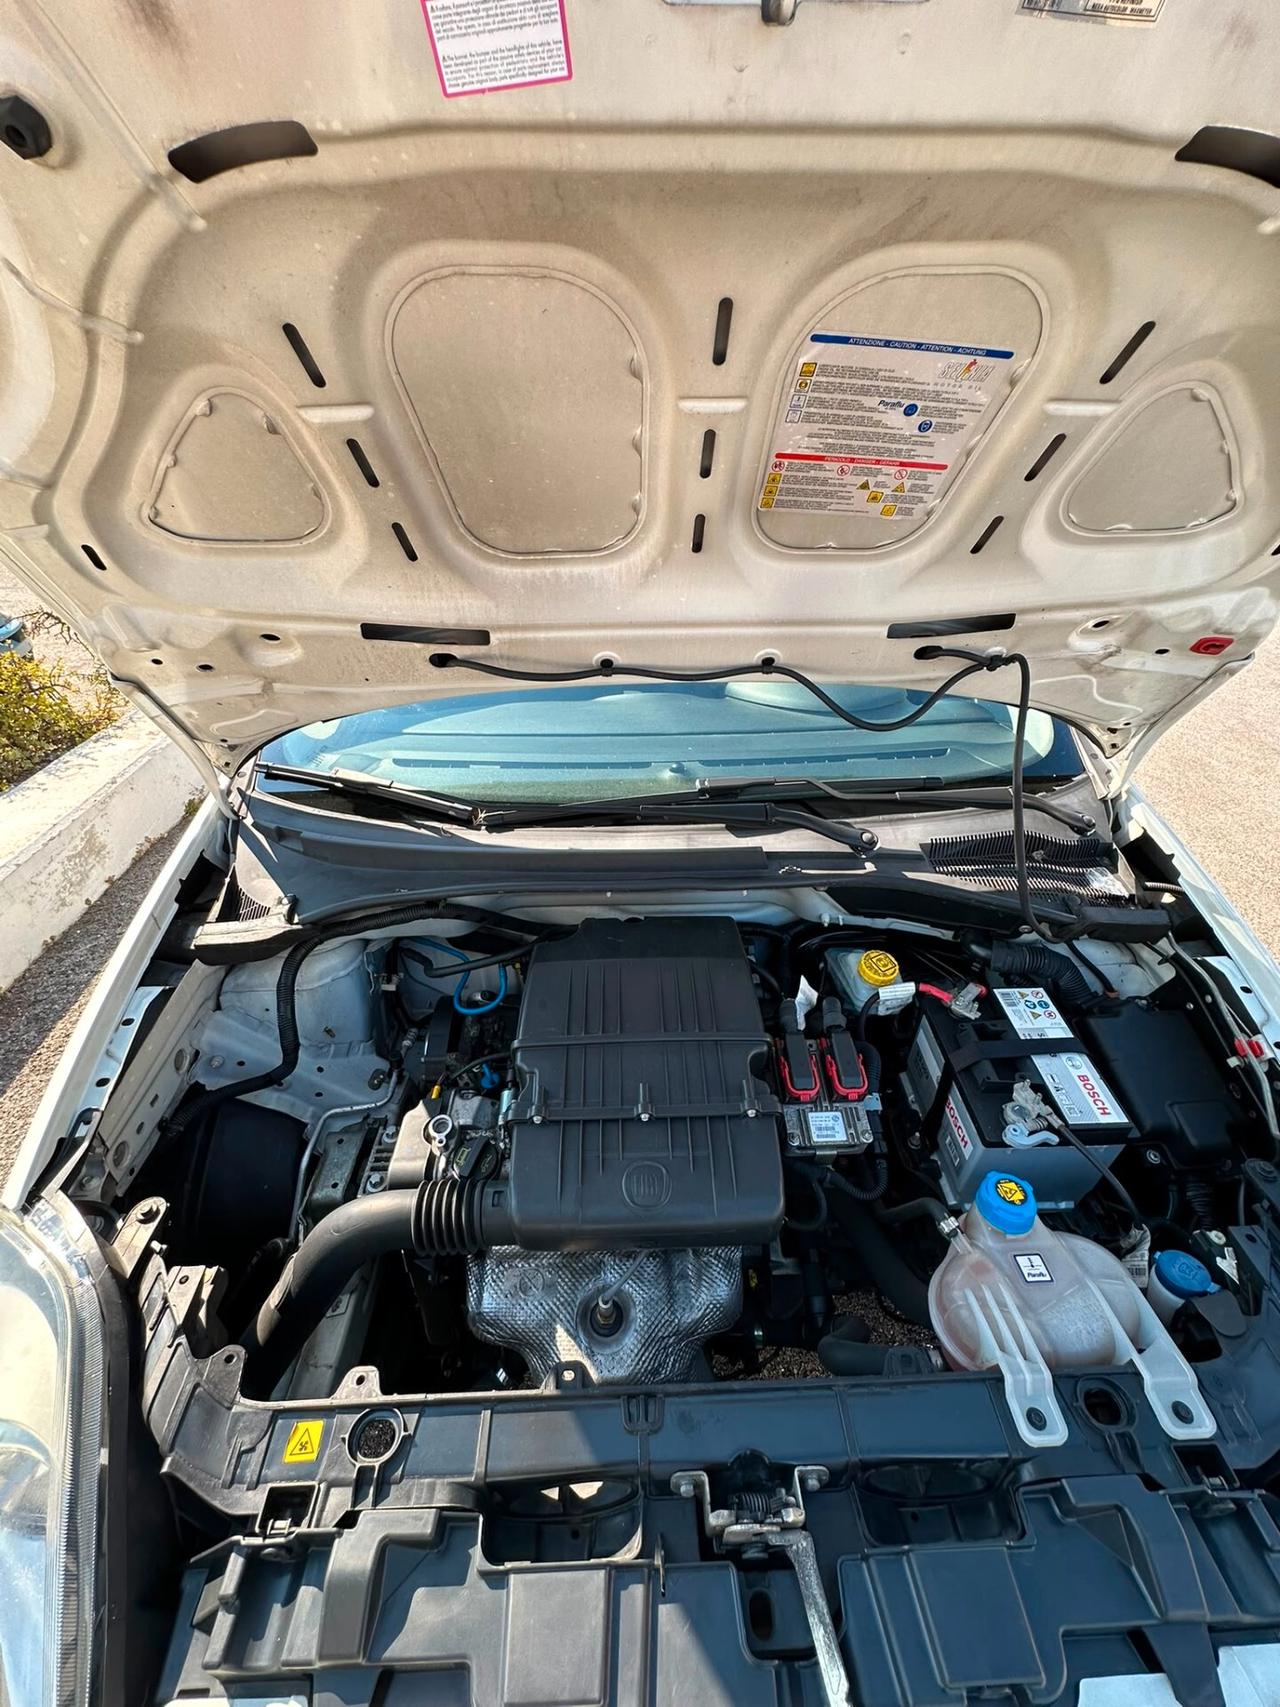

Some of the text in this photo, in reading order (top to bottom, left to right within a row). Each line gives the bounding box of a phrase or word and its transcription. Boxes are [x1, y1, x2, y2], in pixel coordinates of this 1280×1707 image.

[848, 338, 886, 347] ATTENZIONE
[920, 344, 953, 352] ATTENTION
[957, 347, 987, 356] ACHTUNG
[878, 399, 906, 408] Paraflu
[1077, 1074, 1112, 1117] BOSCH
